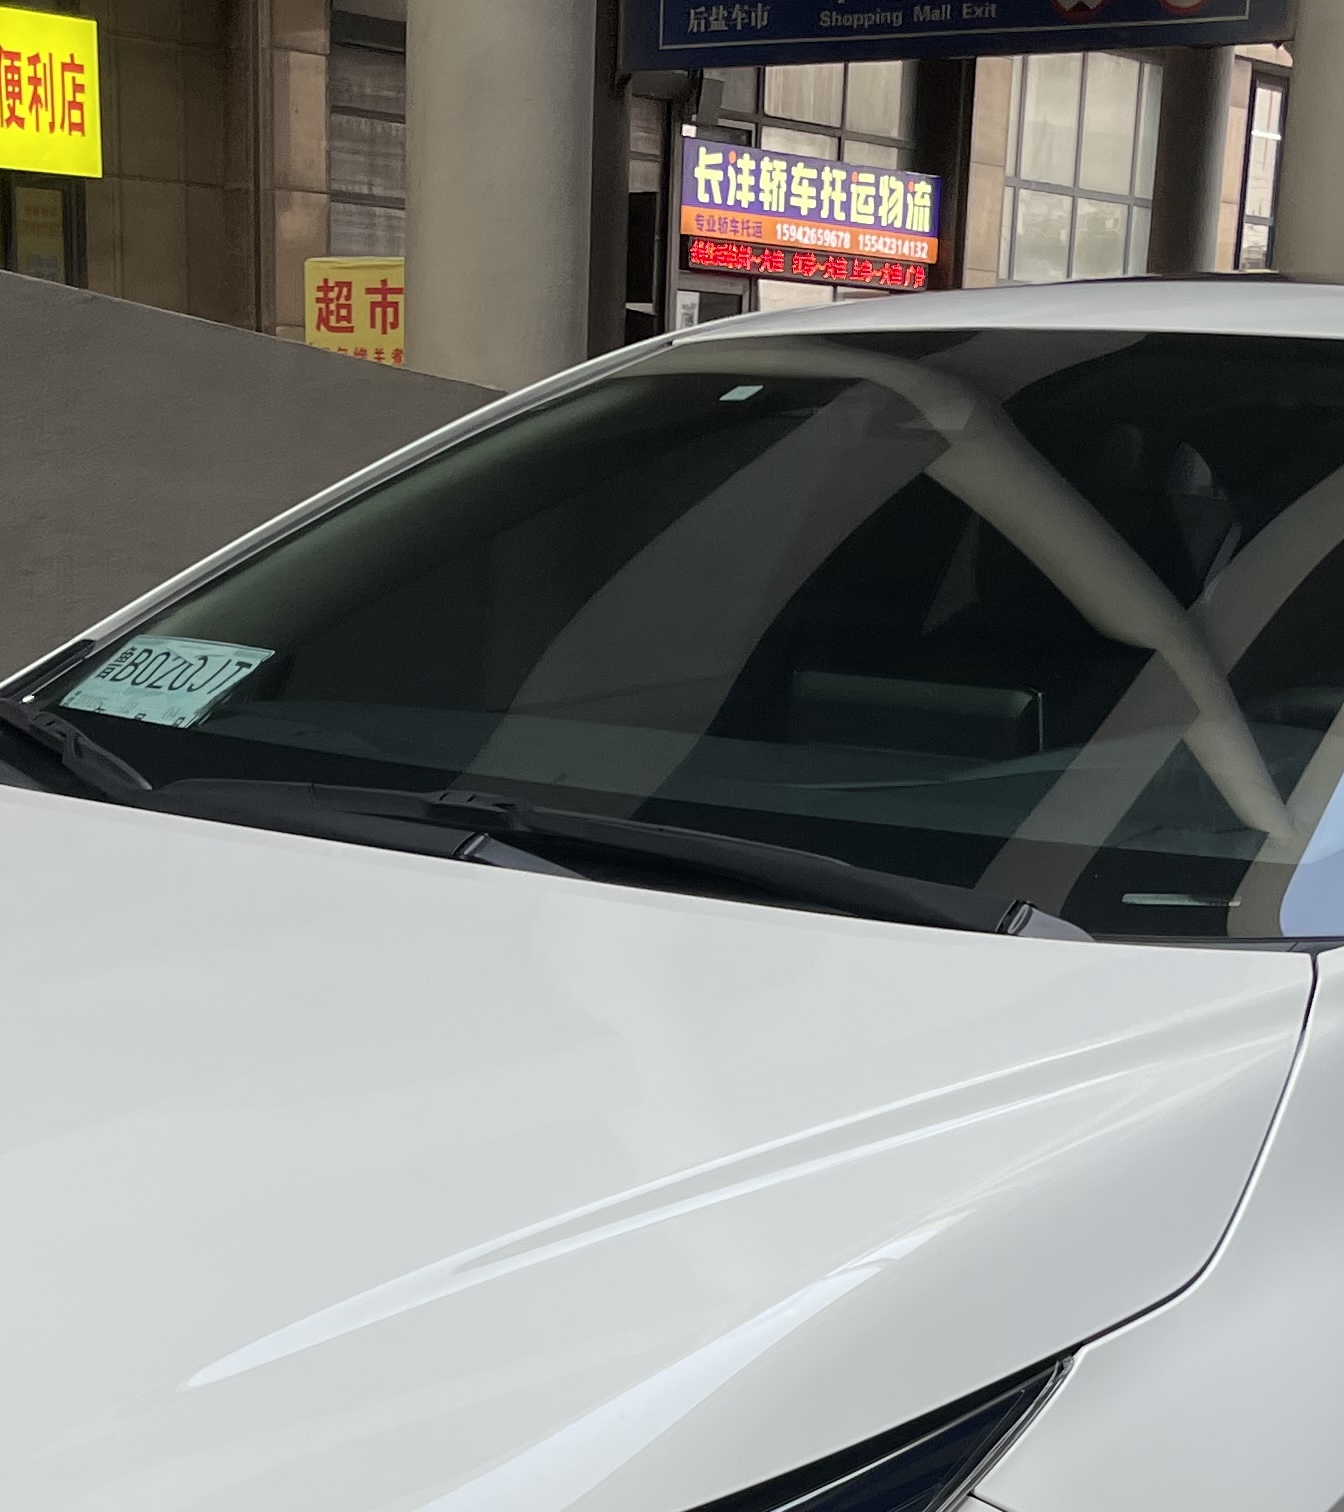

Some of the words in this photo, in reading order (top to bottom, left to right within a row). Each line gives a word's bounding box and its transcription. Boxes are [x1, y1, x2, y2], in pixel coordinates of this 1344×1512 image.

[819, 10, 903, 28] Shopping
[913, 6, 951, 22] Mall
[962, 2, 997, 18] Exit
[694, 213, 763, 238] 专业轿车托运
[775, 223, 851, 250] 15942659678
[858, 233, 929, 259] 15542314132
[315, 278, 404, 335] 超市
